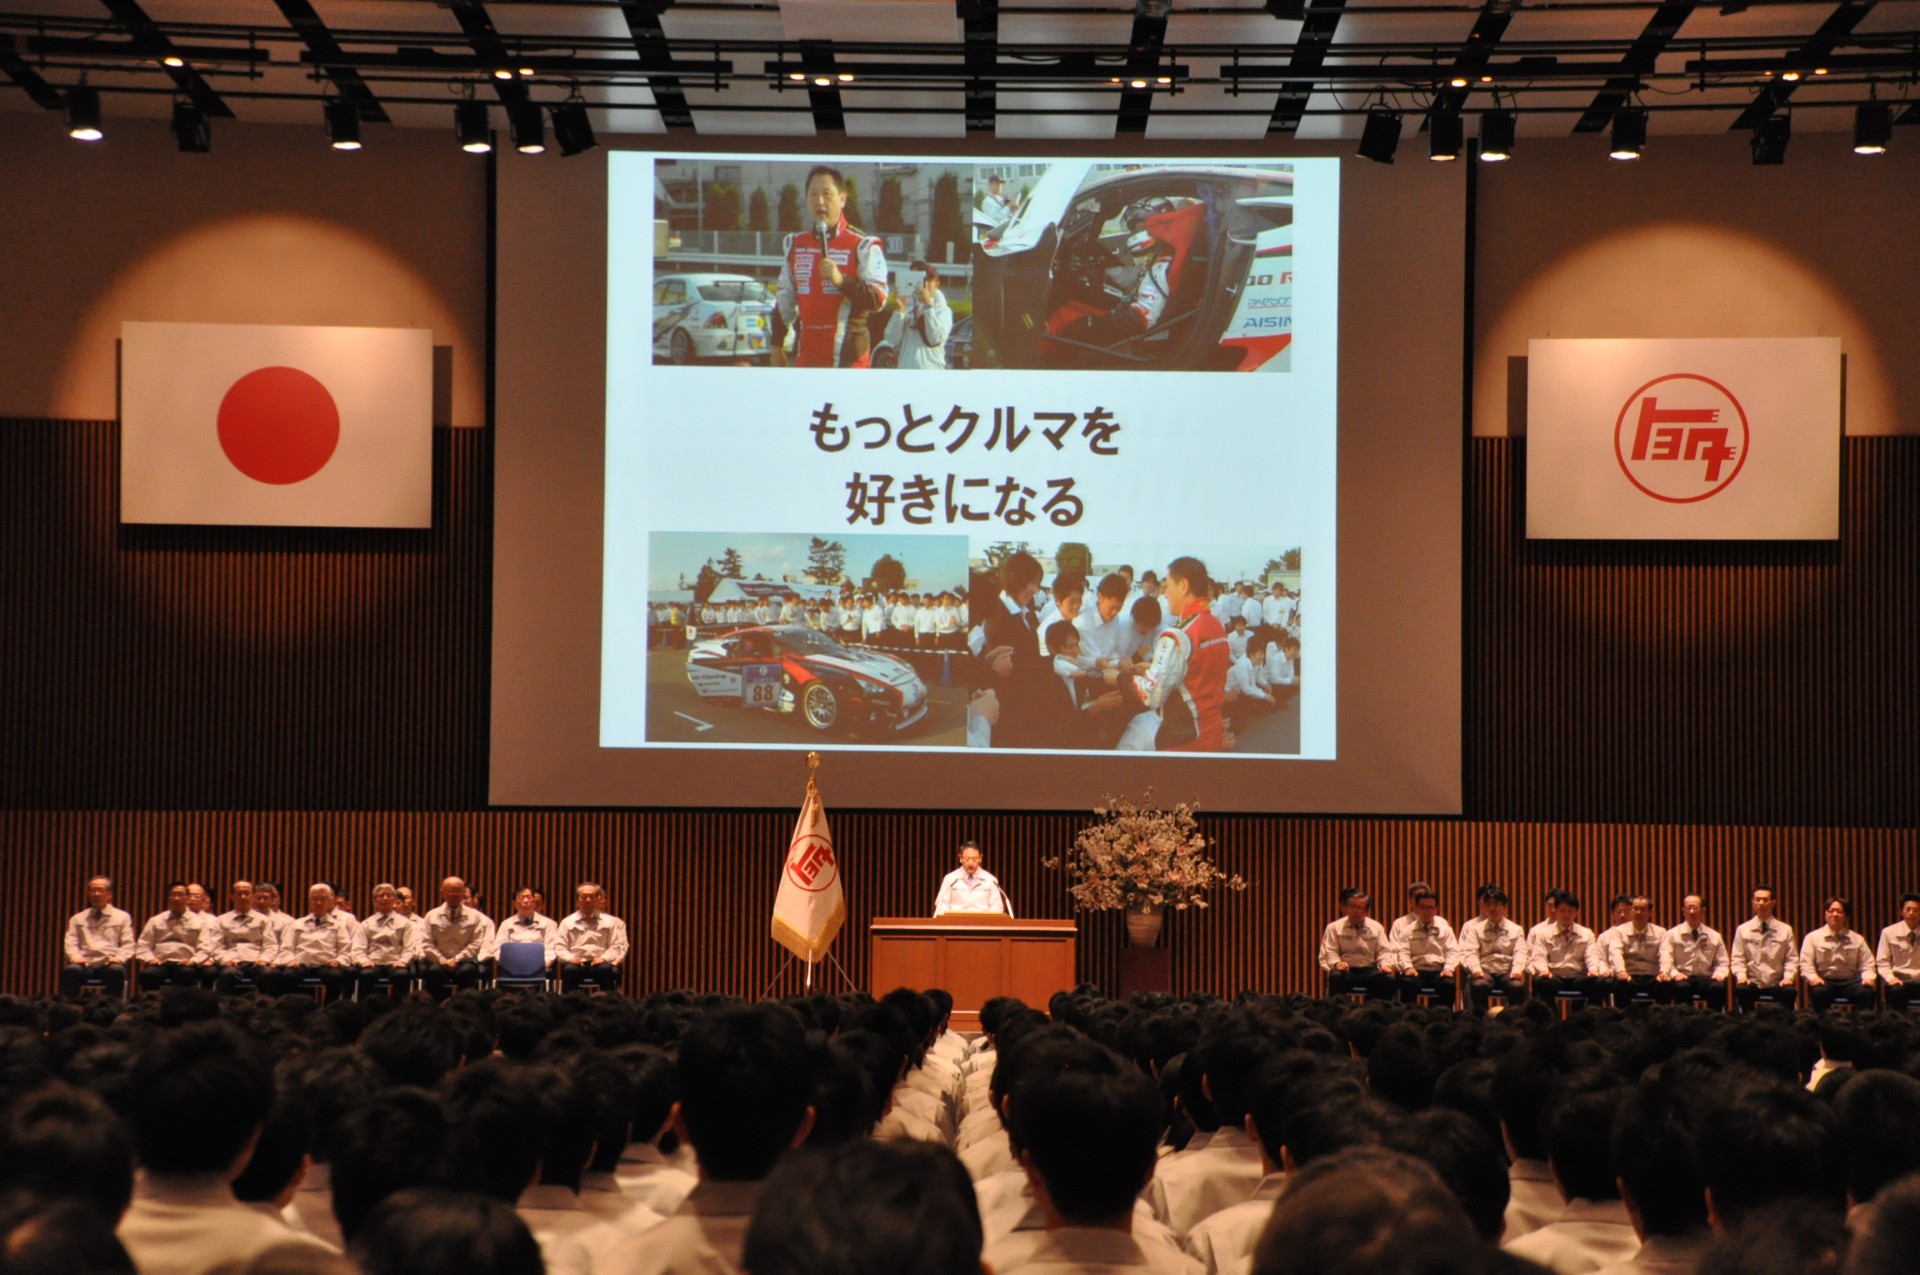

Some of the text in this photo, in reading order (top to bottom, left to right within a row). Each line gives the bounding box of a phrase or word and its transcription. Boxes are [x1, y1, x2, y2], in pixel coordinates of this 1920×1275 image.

[809, 402, 1121, 456] もっとクルマを
[845, 471, 1084, 527] 好きになる
[753, 684, 774, 702] 88
